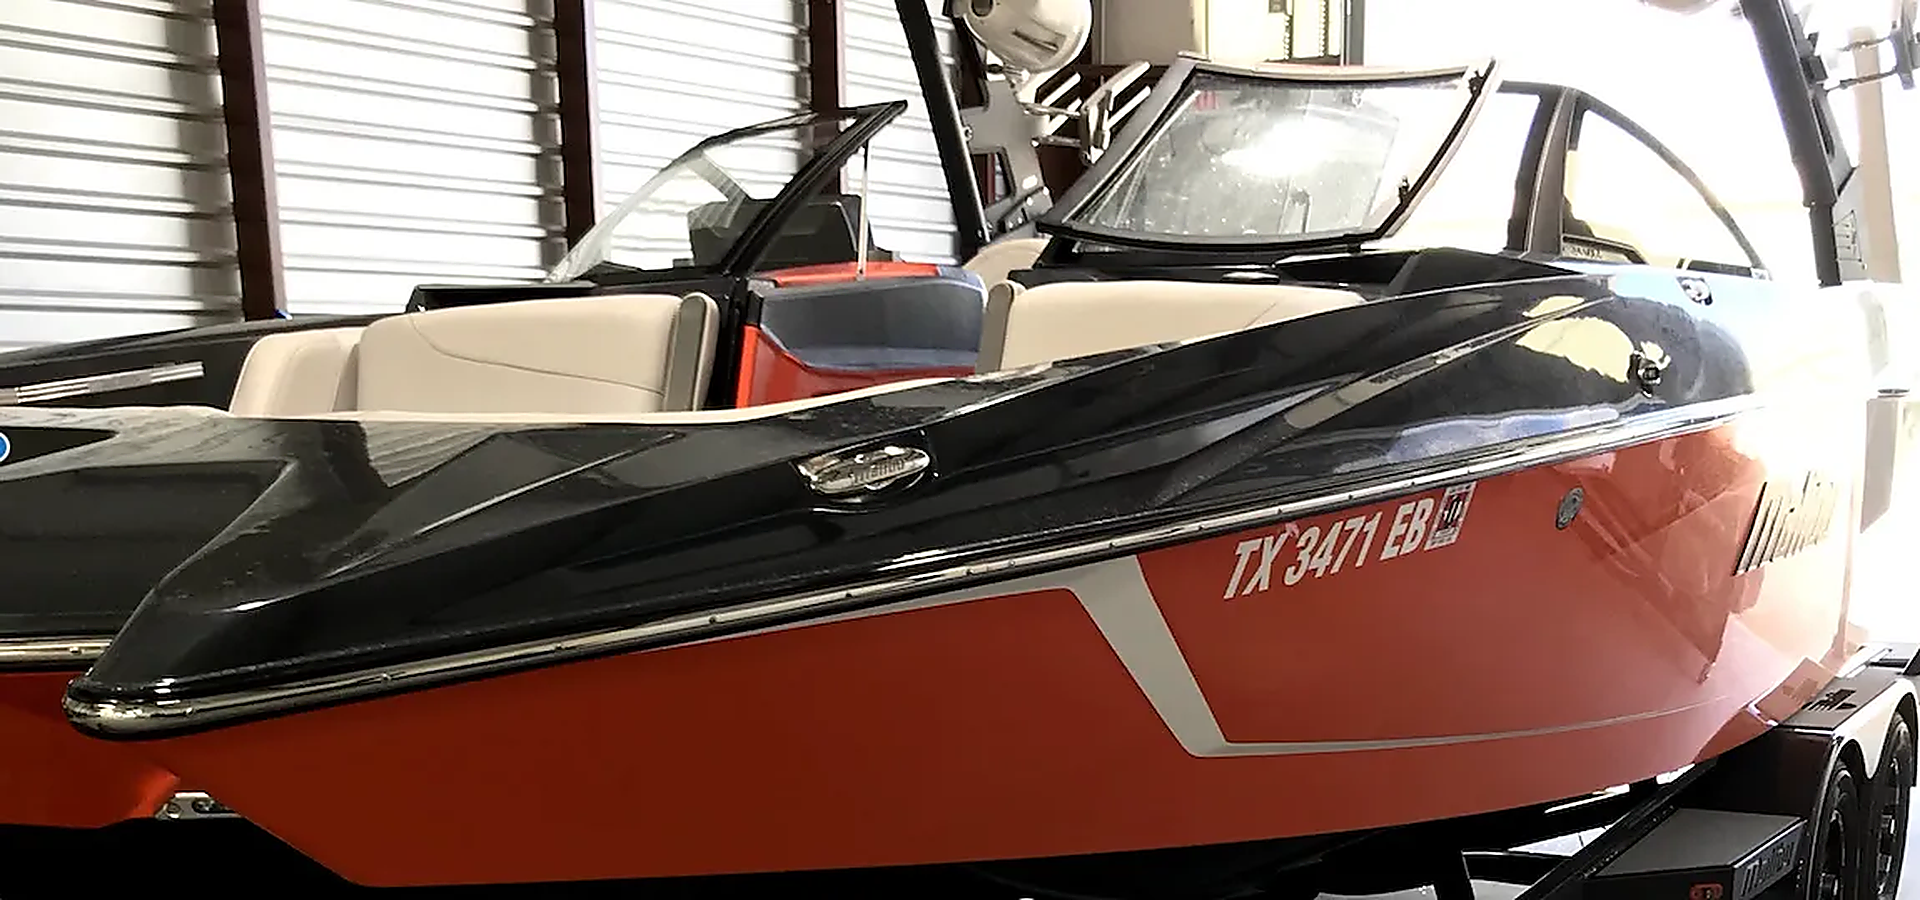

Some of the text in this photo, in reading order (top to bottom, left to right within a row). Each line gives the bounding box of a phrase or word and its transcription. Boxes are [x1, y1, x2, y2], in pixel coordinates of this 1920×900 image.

[1223, 533, 1289, 600] TX
[1284, 511, 1383, 586] 3471
[1380, 498, 1435, 561] EB
